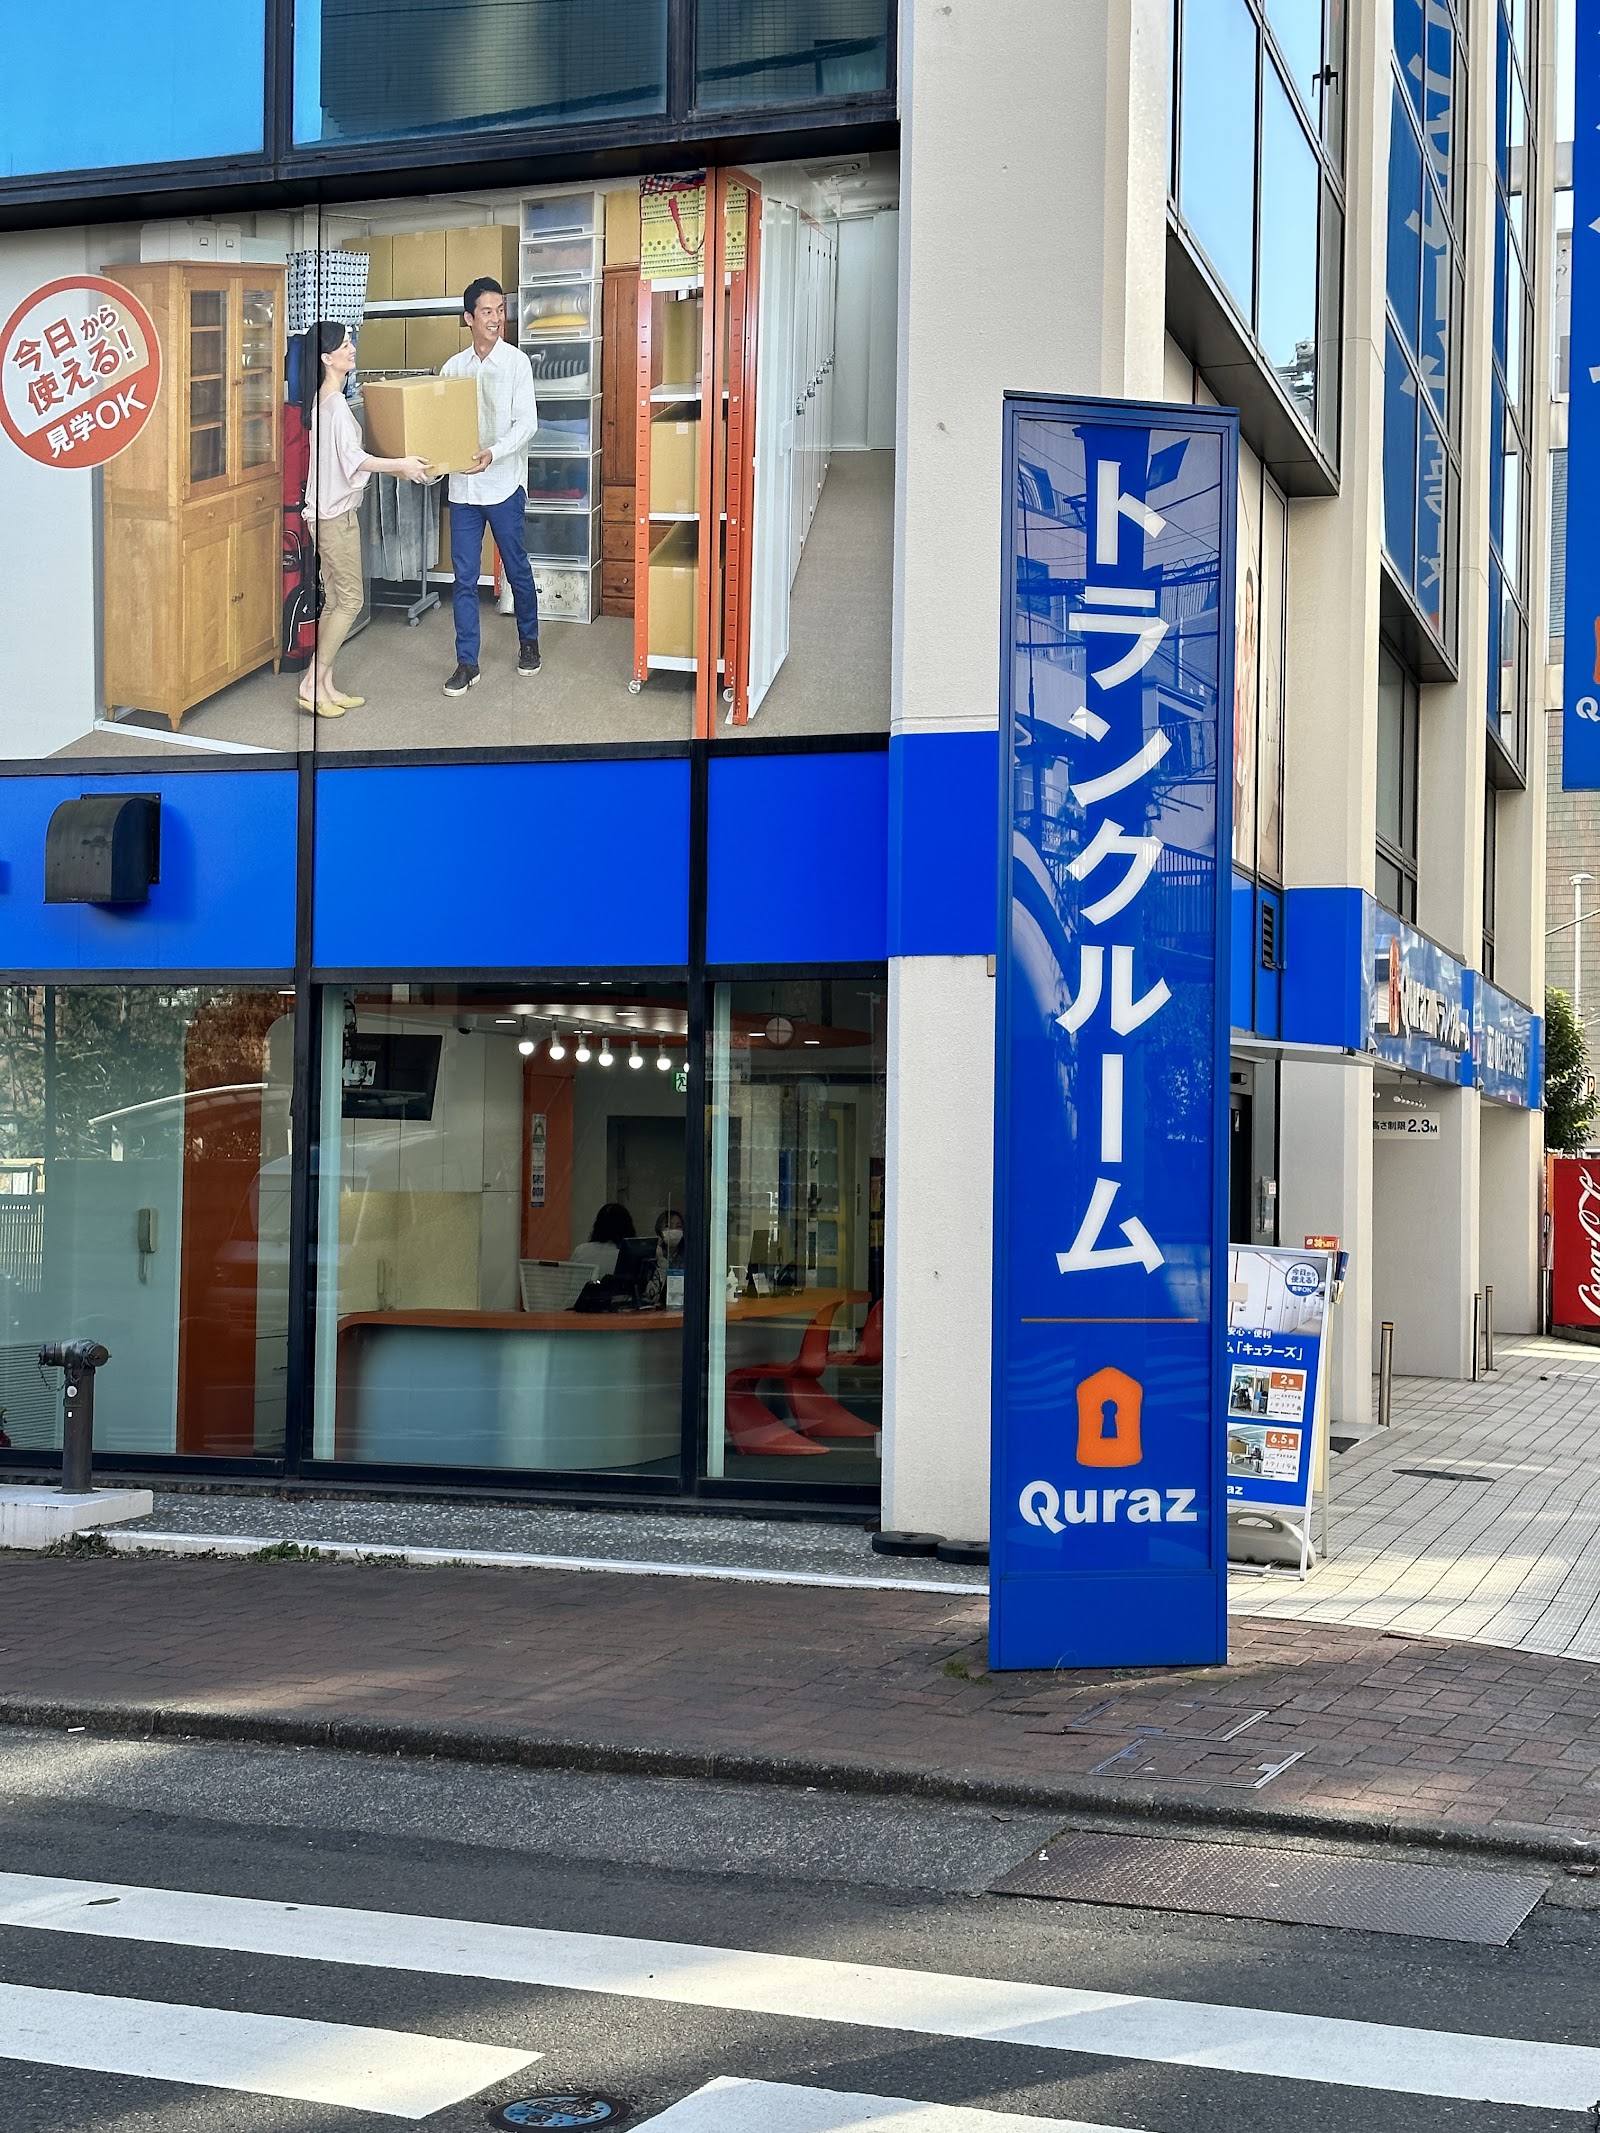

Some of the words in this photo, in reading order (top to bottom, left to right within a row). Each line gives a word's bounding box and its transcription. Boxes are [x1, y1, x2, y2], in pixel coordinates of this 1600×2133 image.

[12, 306, 118, 372] 今日から
[46, 384, 147, 458] 見学OK
[1055, 459, 1172, 1274] トランクルーム
[1373, 1120, 1406, 1131] 高さ制限
[1408, 1119, 1438, 1133] 2.3M
[1019, 1480, 1197, 1534] Quraz
